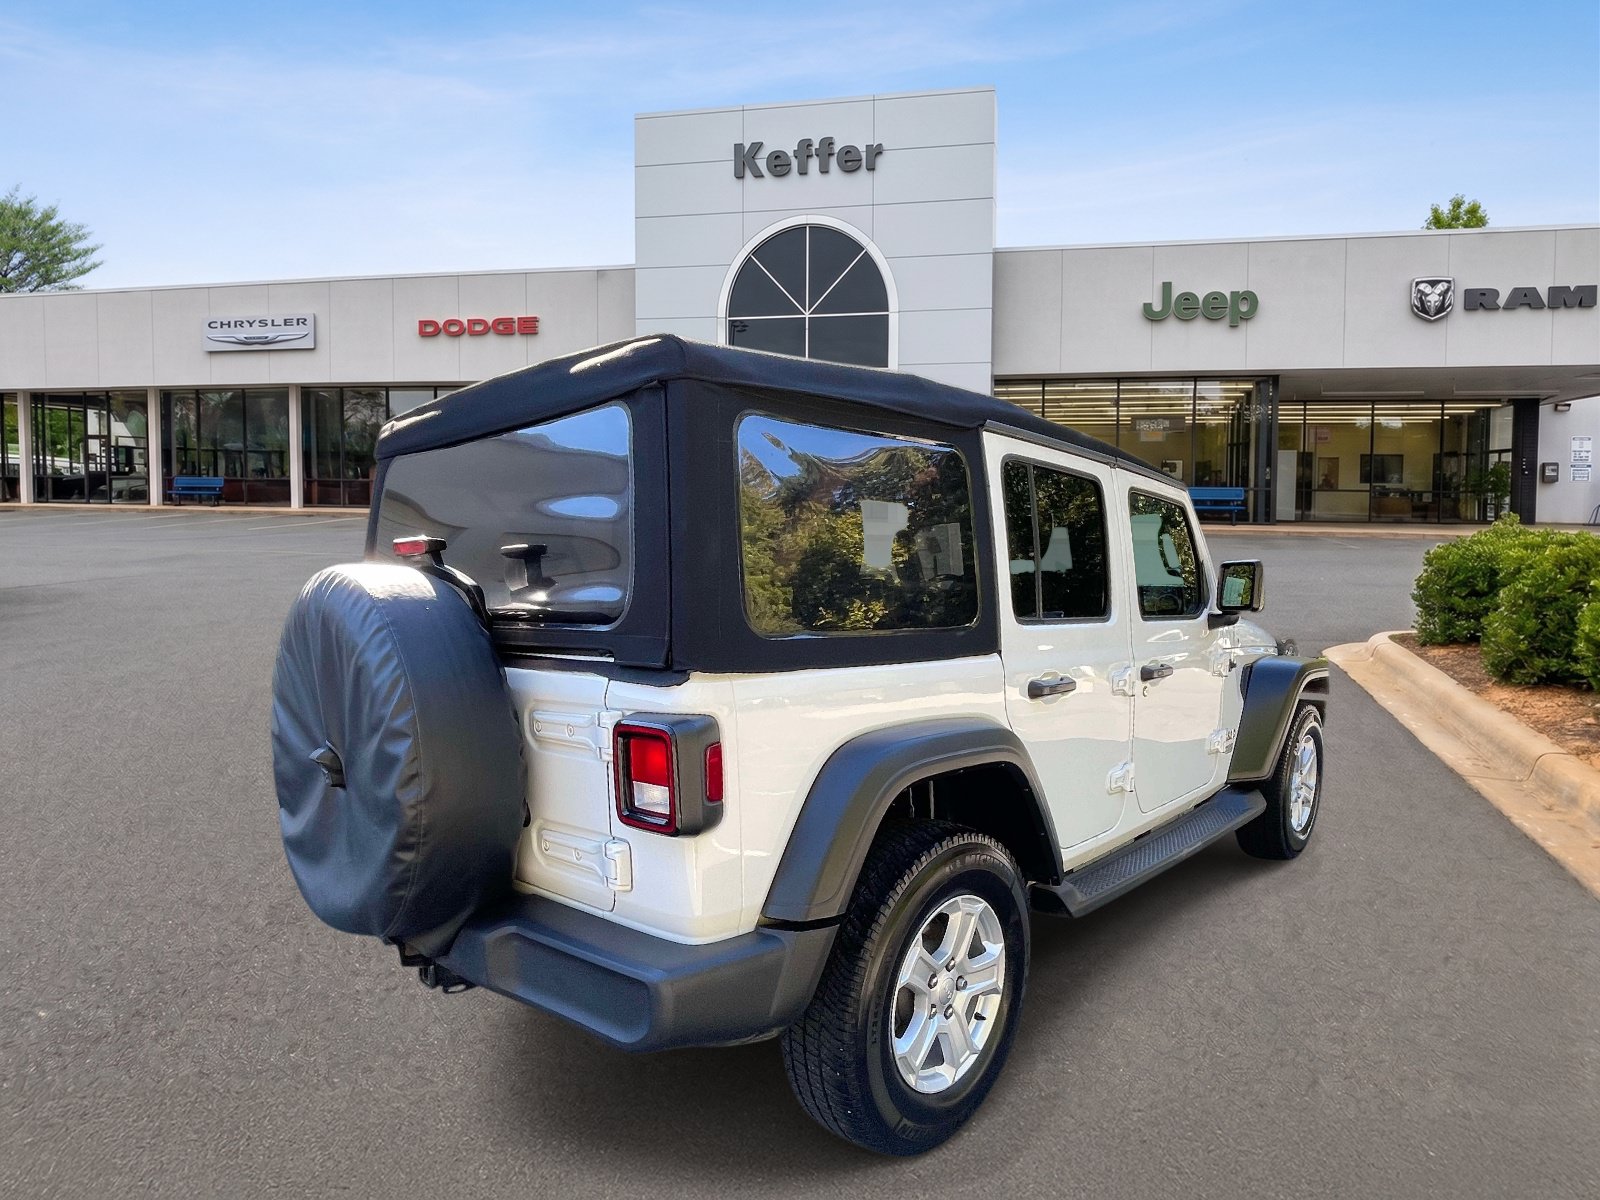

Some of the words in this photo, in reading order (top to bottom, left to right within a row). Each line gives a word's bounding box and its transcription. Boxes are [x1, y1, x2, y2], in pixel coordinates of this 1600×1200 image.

[734, 137, 883, 178] Keffer
[1143, 281, 1259, 327] Jeep
[1464, 285, 1598, 310] RAM
[207, 317, 308, 330] CHRYSLER
[418, 316, 540, 337] DODGE
